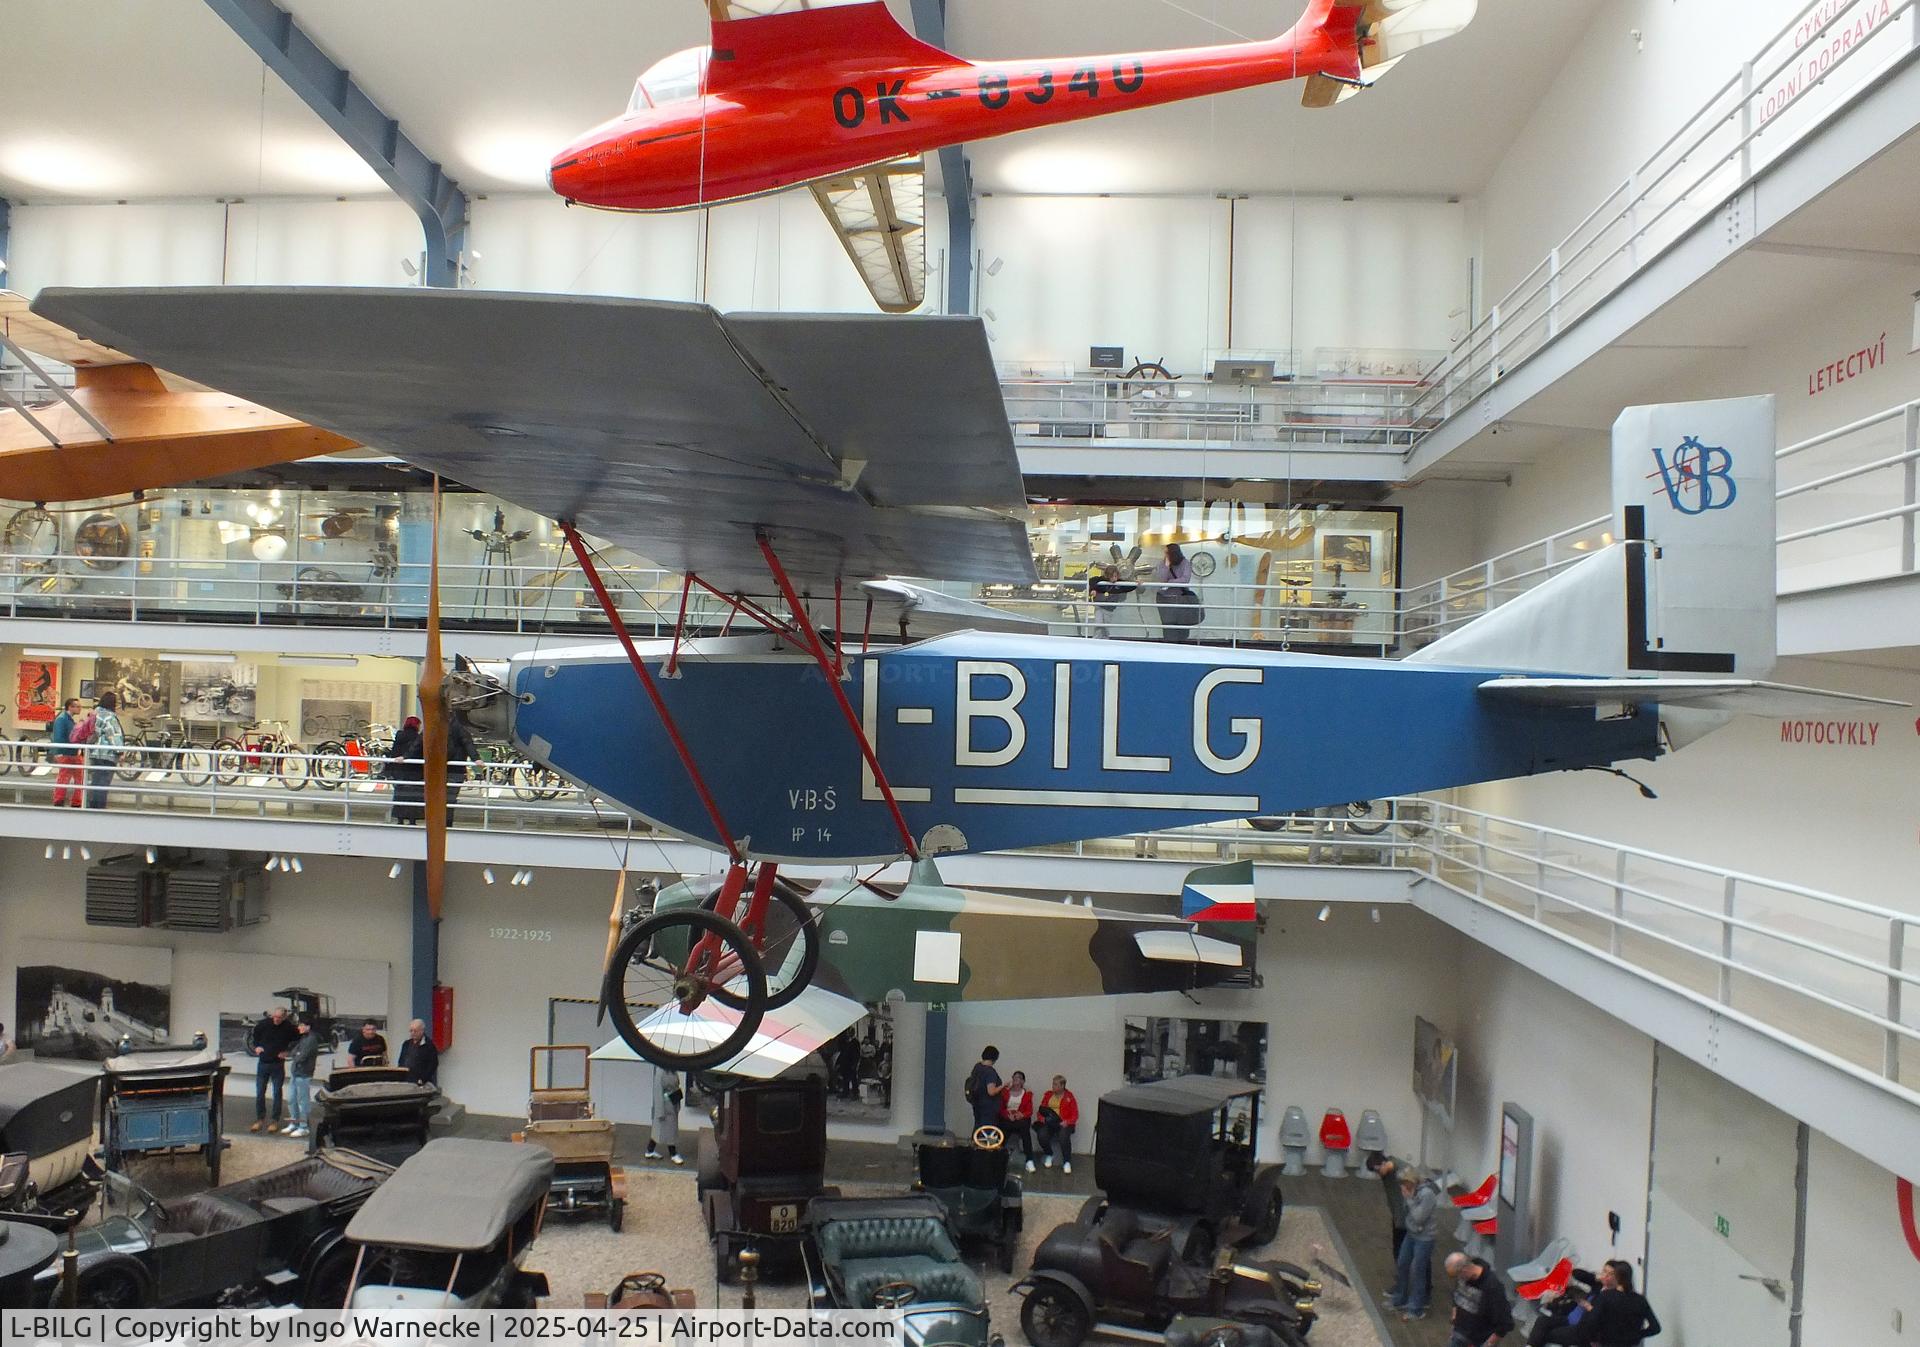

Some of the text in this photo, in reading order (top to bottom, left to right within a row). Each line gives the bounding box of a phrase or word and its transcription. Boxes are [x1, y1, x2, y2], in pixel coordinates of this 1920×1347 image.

[1760, 0, 1890, 124] LODNÍ DOPRAVA
[1808, 332, 1886, 396] LETECTVÍ
[861, 657, 1264, 803] L-BILG
[1781, 721, 1879, 746] MOTOCYKLY
[817, 827, 832, 842] 14
[489, 928, 552, 942] 1922-1925
